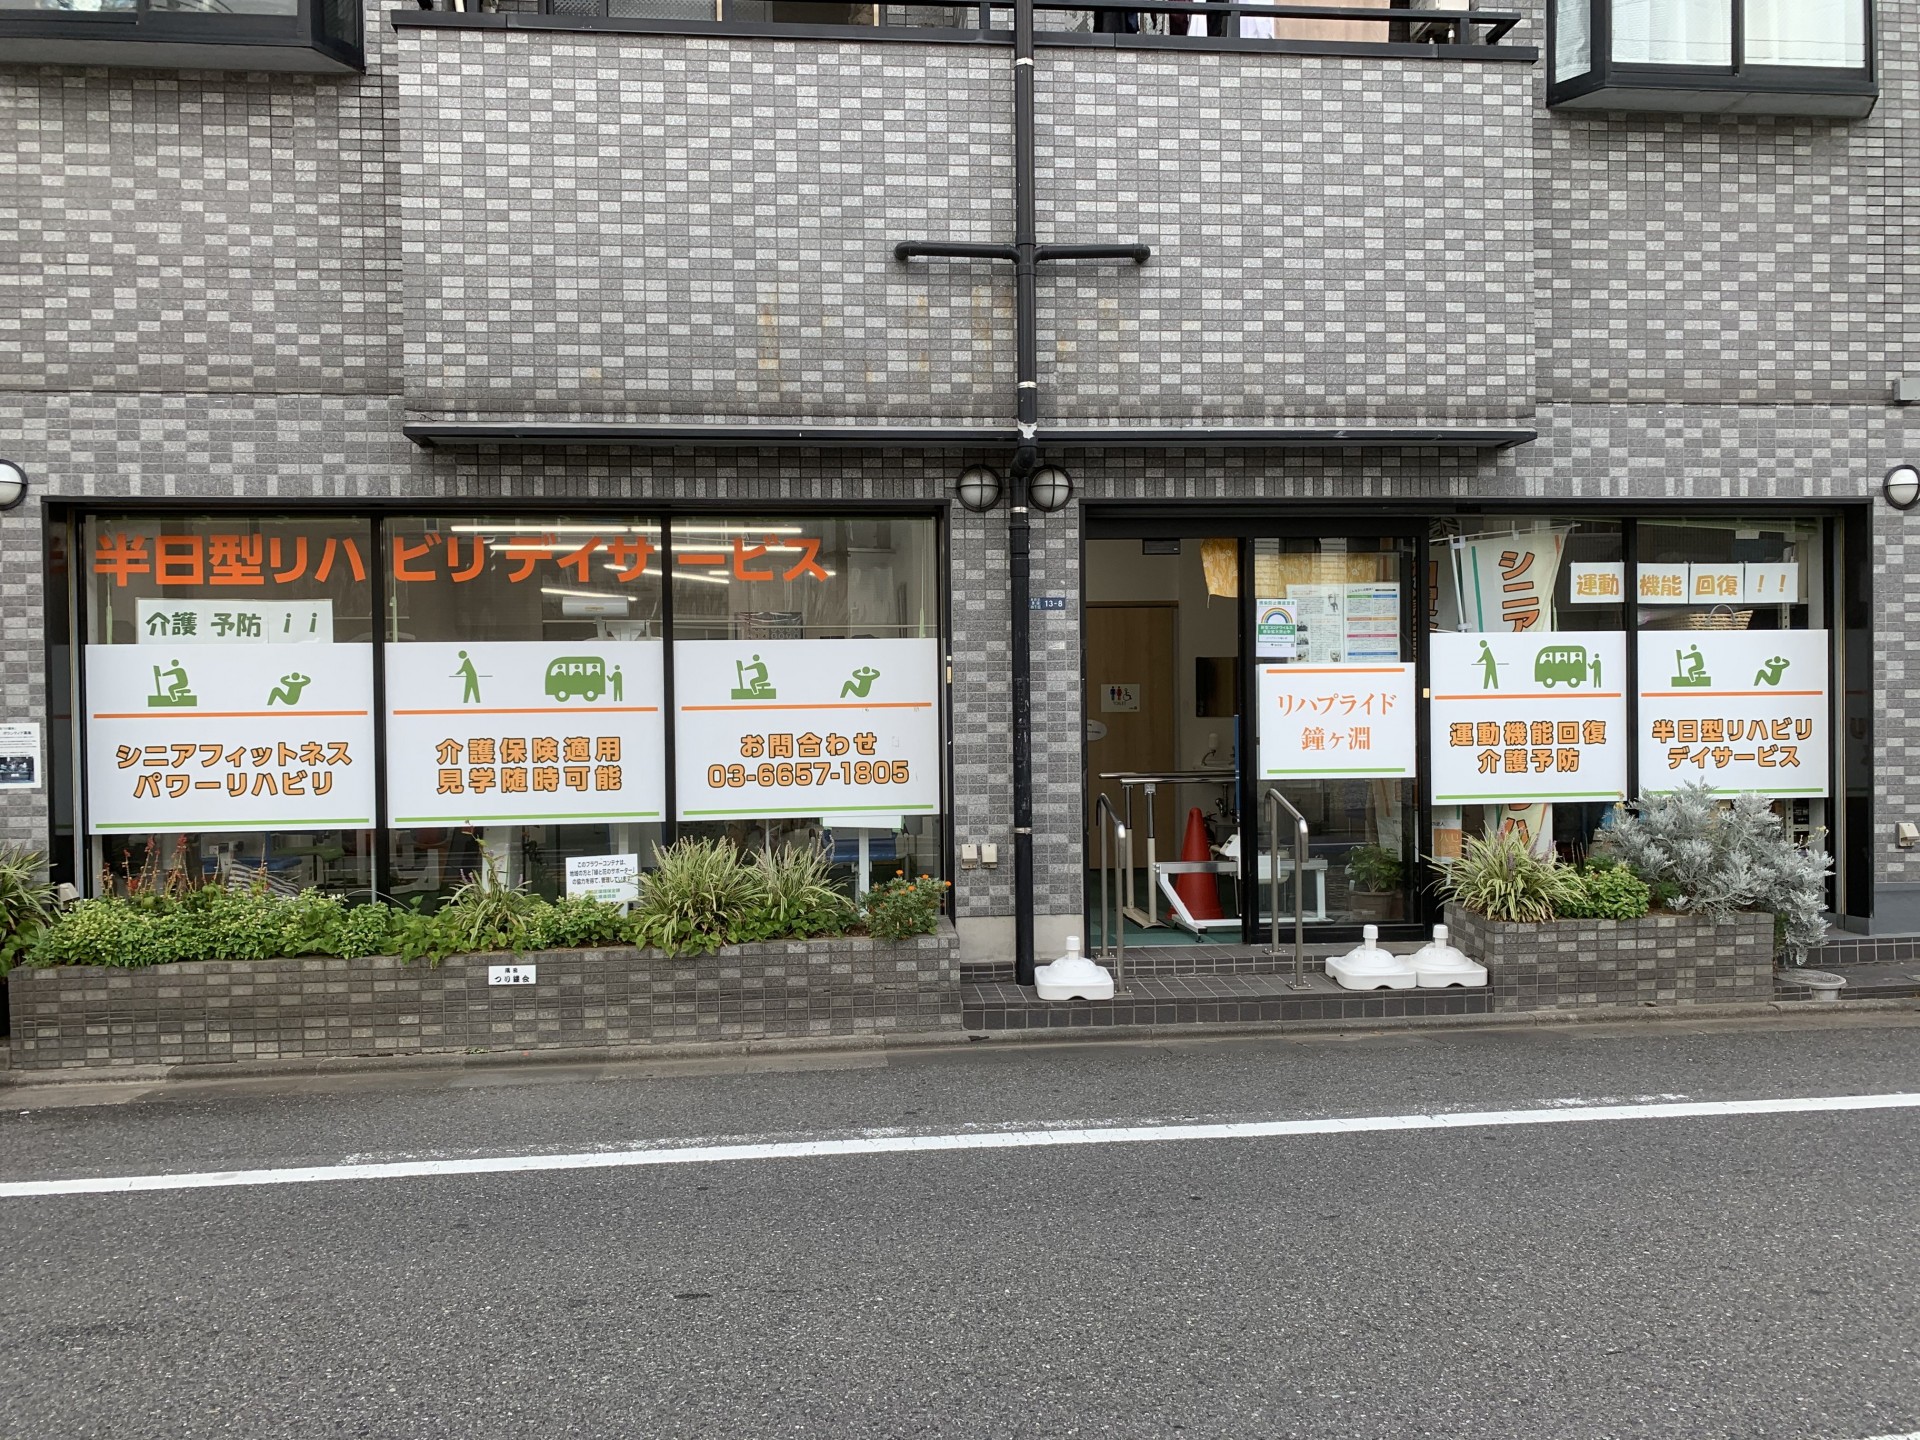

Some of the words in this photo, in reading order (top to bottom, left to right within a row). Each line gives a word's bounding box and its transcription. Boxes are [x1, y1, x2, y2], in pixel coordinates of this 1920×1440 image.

[1044, 600, 1063, 608] 13-8
[1278, 693, 1398, 717] リハプライド
[1450, 720, 1607, 748] 運動機能回復
[1652, 718, 1813, 744] 半日型リハビリ
[116, 742, 352, 769] シニアフィットネス
[436, 736, 621, 765] 介護保険適用
[740, 732, 877, 759] お問合わせ
[1667, 745, 1801, 770] デイサービス
[707, 760, 910, 788] 03-6657-1805
[1478, 748, 1580, 774] 介護予防
[133, 770, 333, 798] パワーリハビリ
[437, 765, 622, 794] 見学随時可能
